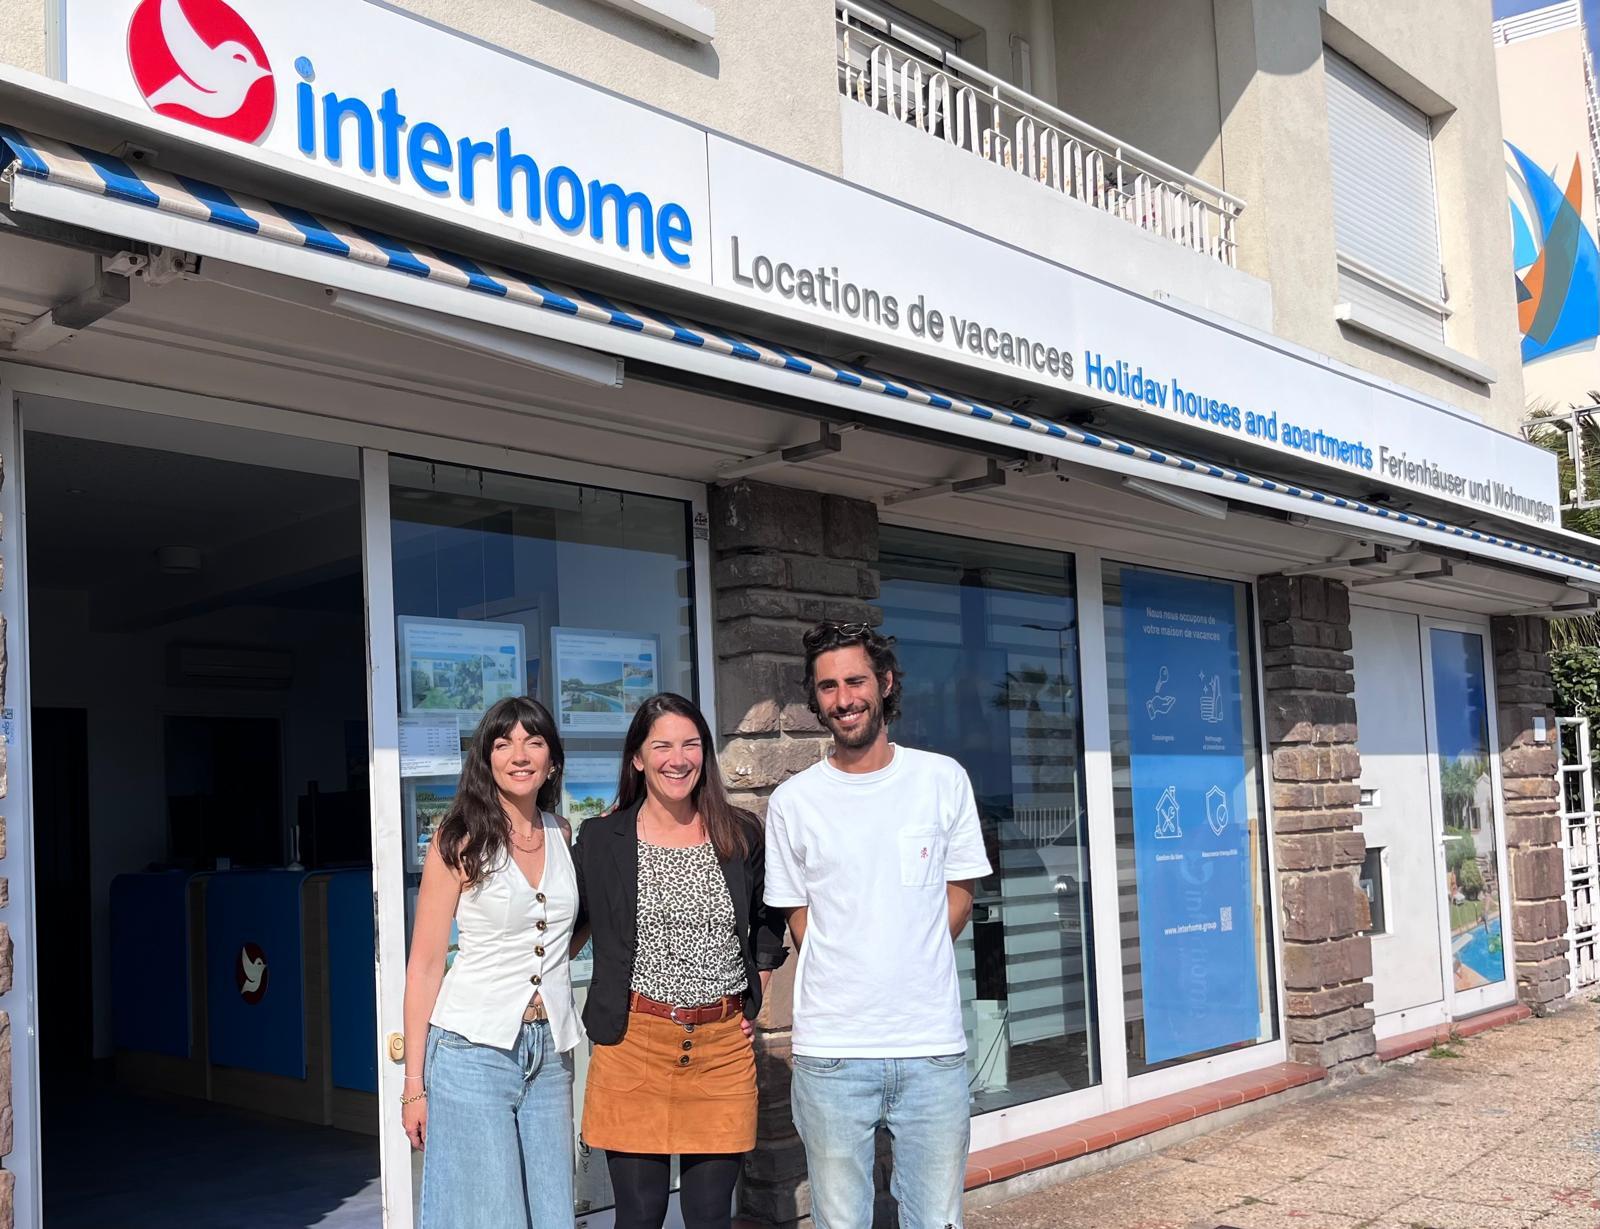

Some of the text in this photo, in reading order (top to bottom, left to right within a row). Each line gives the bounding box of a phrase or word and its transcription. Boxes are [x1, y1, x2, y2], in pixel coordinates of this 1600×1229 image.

[294, 55, 693, 266] interhome
[731, 235, 1554, 523] Locations de vacances Holiday houses and apartments Ferienhäuser und Wohnungen
[1146, 607, 1216, 624] Nous nous occupons de
[1142, 625, 1220, 641] votre maison de vacances
[1164, 922, 1217, 935] www.interhome.group
